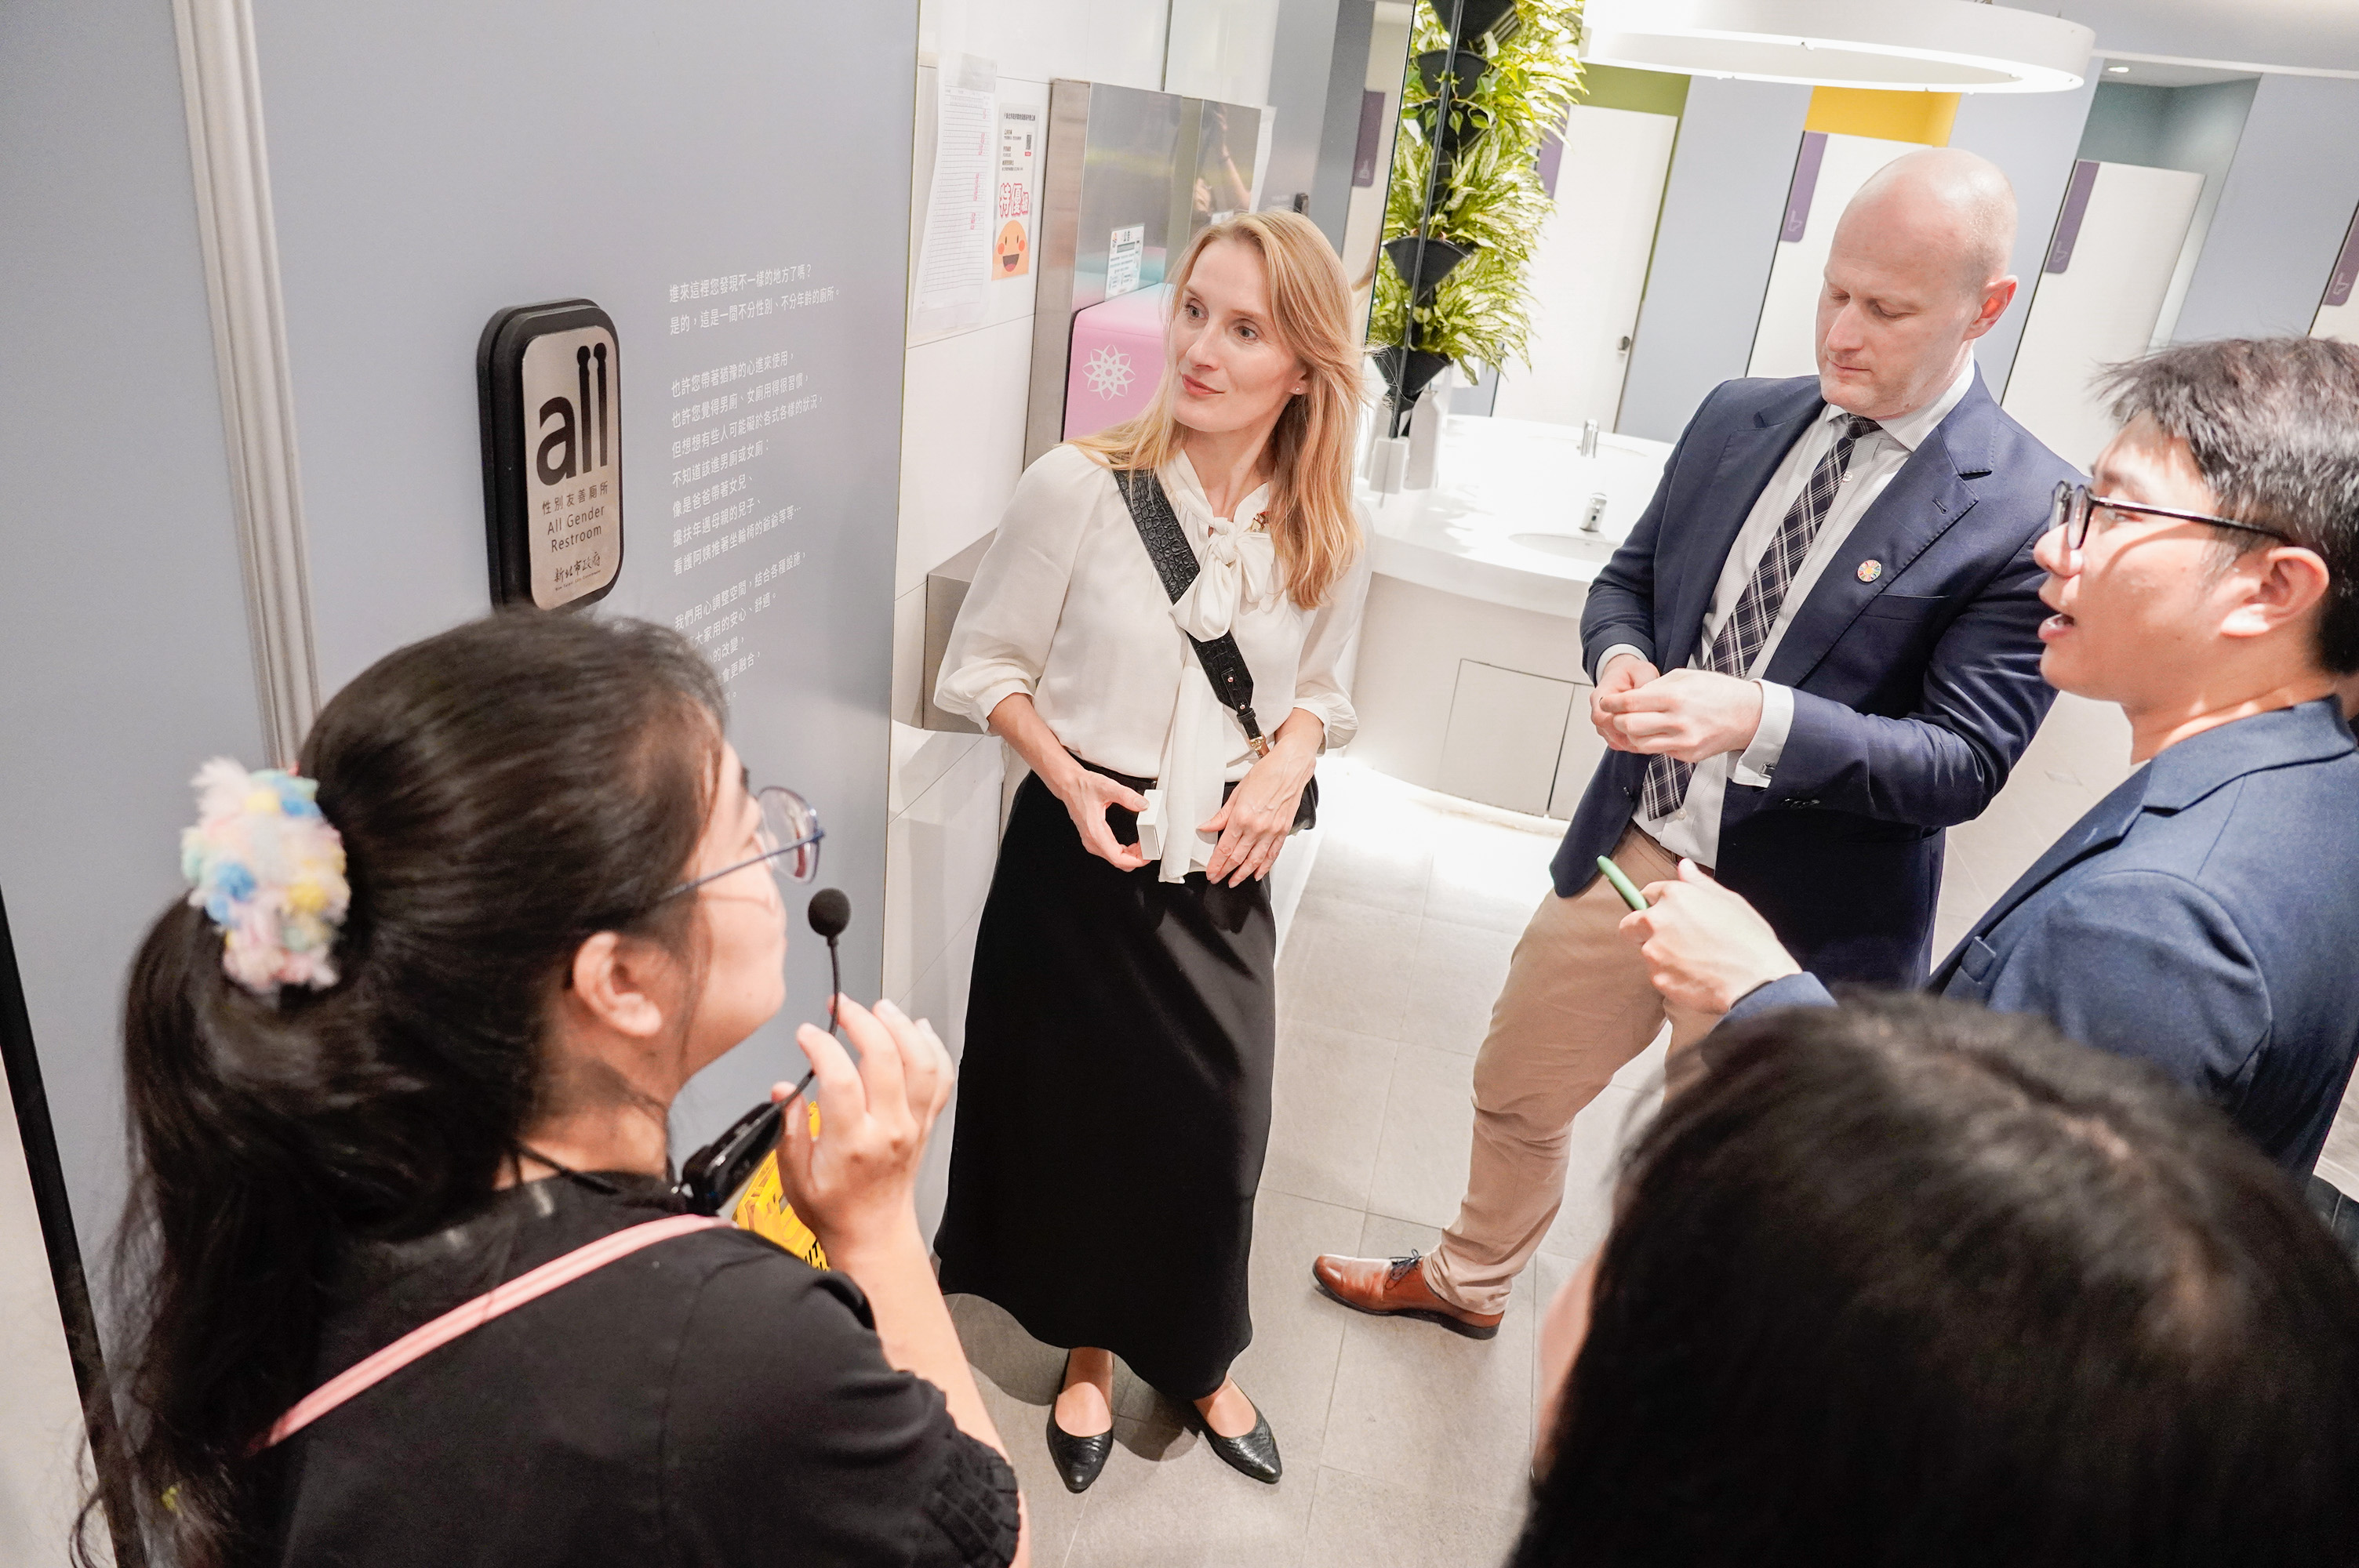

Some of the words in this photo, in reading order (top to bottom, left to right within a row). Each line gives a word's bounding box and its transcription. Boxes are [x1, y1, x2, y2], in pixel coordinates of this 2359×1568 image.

[669, 263, 812, 303] 進來這裡您發現不一樣的地方了嗎？
[671, 350, 794, 398] 也許您帶著猶豫的心進來使用，
[536, 342, 608, 486] all
[672, 438, 769, 489] 不知道該進男廁或女廁：
[542, 481, 609, 515] 性別友善廁所
[673, 474, 753, 519] 像是爸爸帶著女兒、
[547, 518, 562, 535] All
[567, 505, 605, 528] Gender
[551, 525, 602, 553] Restroom
[554, 551, 601, 583] 新北市政府
